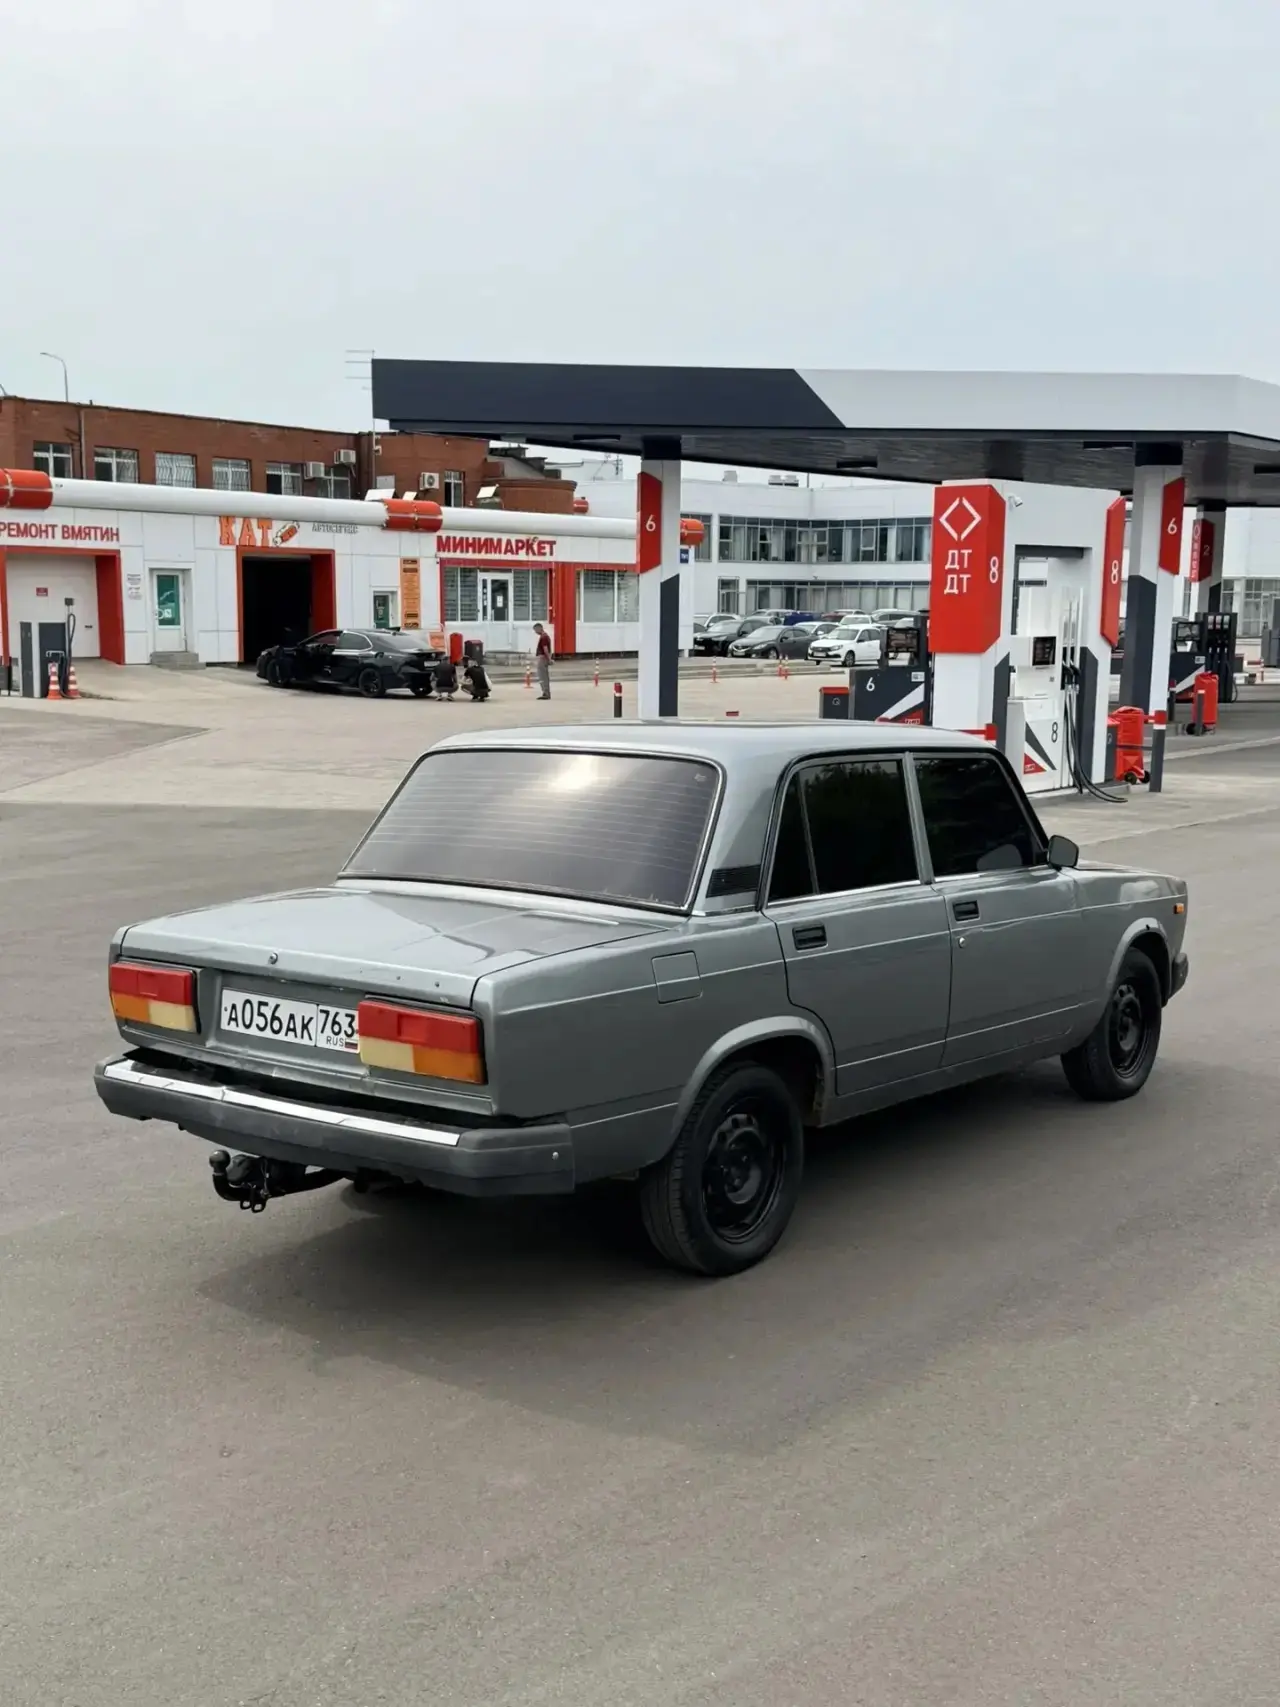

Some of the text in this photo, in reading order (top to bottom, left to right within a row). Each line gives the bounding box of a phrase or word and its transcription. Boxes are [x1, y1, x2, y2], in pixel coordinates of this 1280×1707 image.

[0, 522, 120, 542] РЕМОНТ ВМЯТИН
[646, 514, 656, 532] 6
[1167, 518, 1178, 535] 6
[436, 535, 557, 556] МИНИМАРКЕТ
[945, 549, 972, 570] ДТ
[989, 556, 999, 584] 8
[1111, 559, 1119, 585] 8
[944, 574, 972, 595] ДТ
[866, 677, 875, 692] 6
[1051, 721, 1059, 743] 8
[318, 1009, 356, 1038] 763
[325, 1034, 345, 1047] RUS
